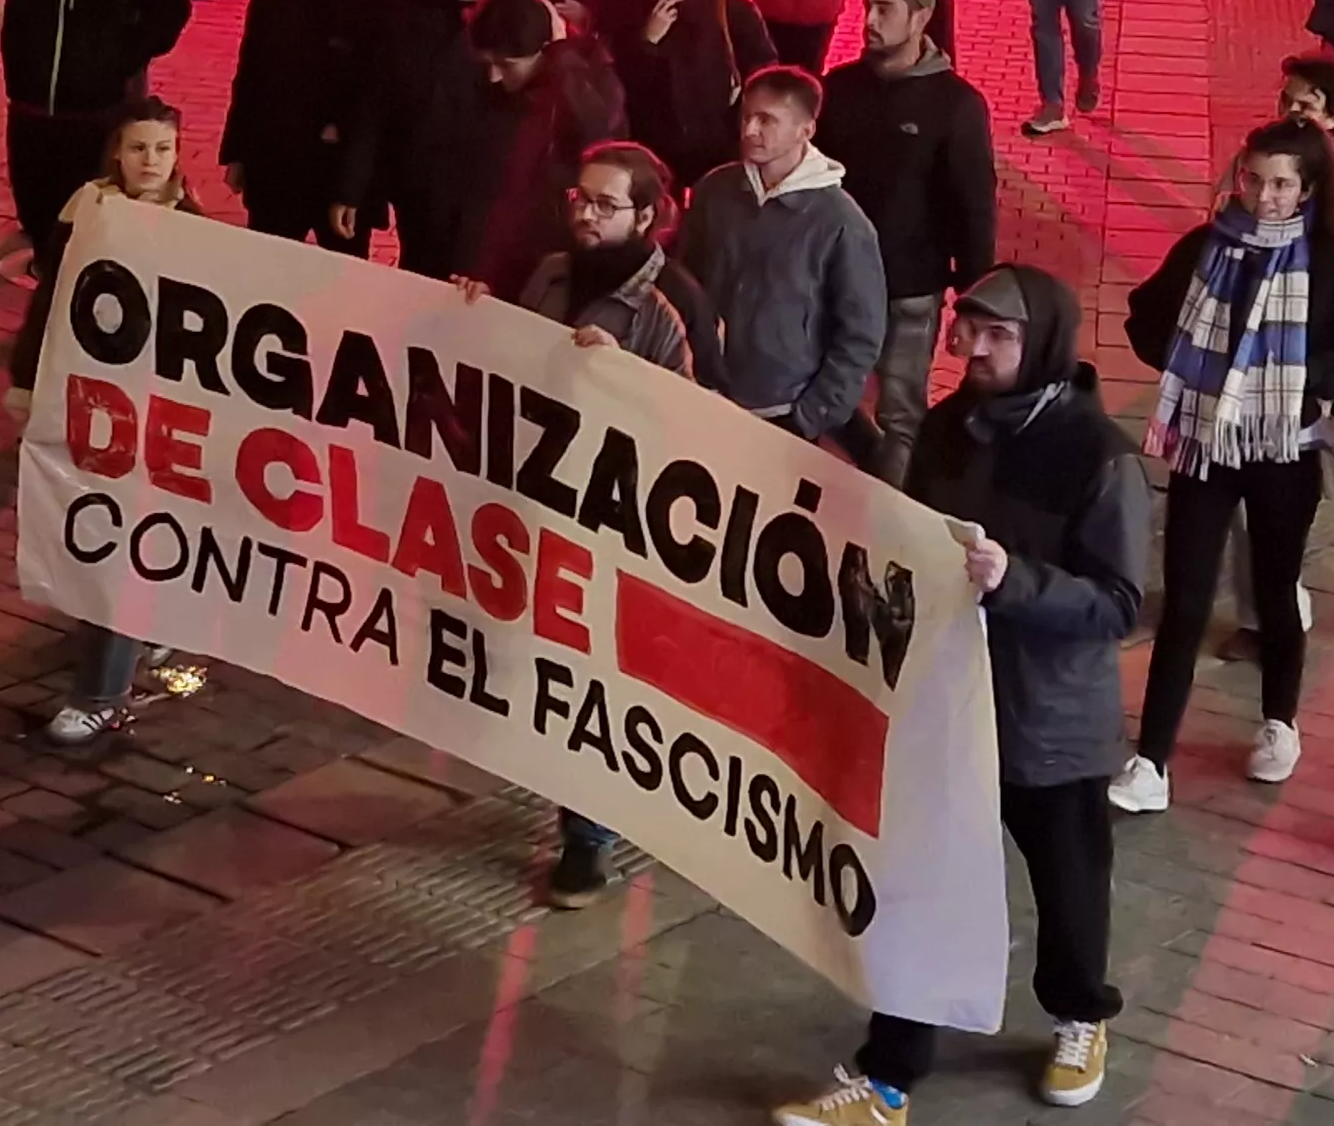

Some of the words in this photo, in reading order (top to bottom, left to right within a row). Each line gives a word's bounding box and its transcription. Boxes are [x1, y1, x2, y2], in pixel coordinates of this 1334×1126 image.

[66, 373, 212, 504] DE
[235, 427, 593, 655] CLASE
[69, 258, 916, 692] ORGANIZACIÓN
[65, 492, 400, 666] CONTRA
[427, 608, 510, 717] EL
[533, 657, 877, 937] FASCISMO
